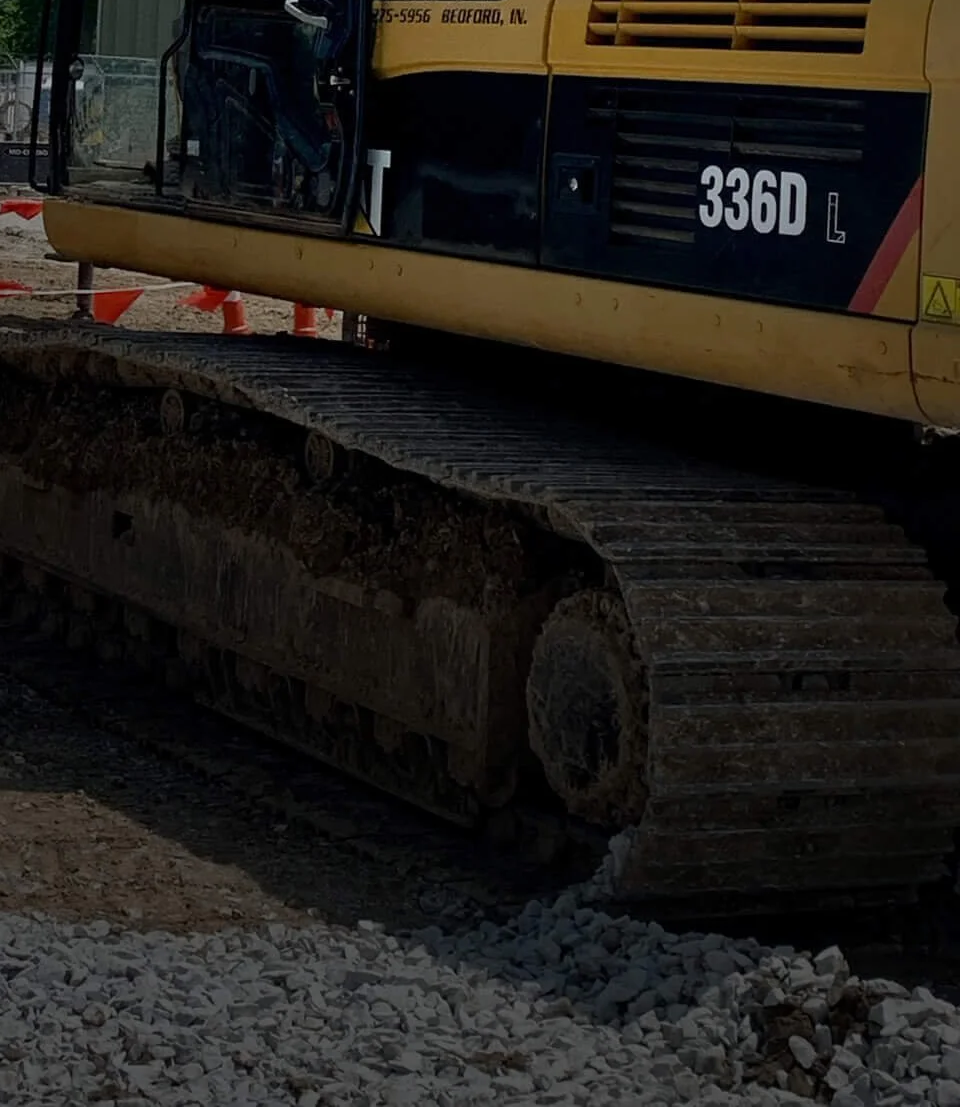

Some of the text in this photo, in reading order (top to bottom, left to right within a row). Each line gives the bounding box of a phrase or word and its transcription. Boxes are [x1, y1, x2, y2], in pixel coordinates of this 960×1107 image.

[441, 8, 504, 25] BEDFORD,
[510, 9, 528, 24] IN.
[698, 164, 846, 244] 336D L
